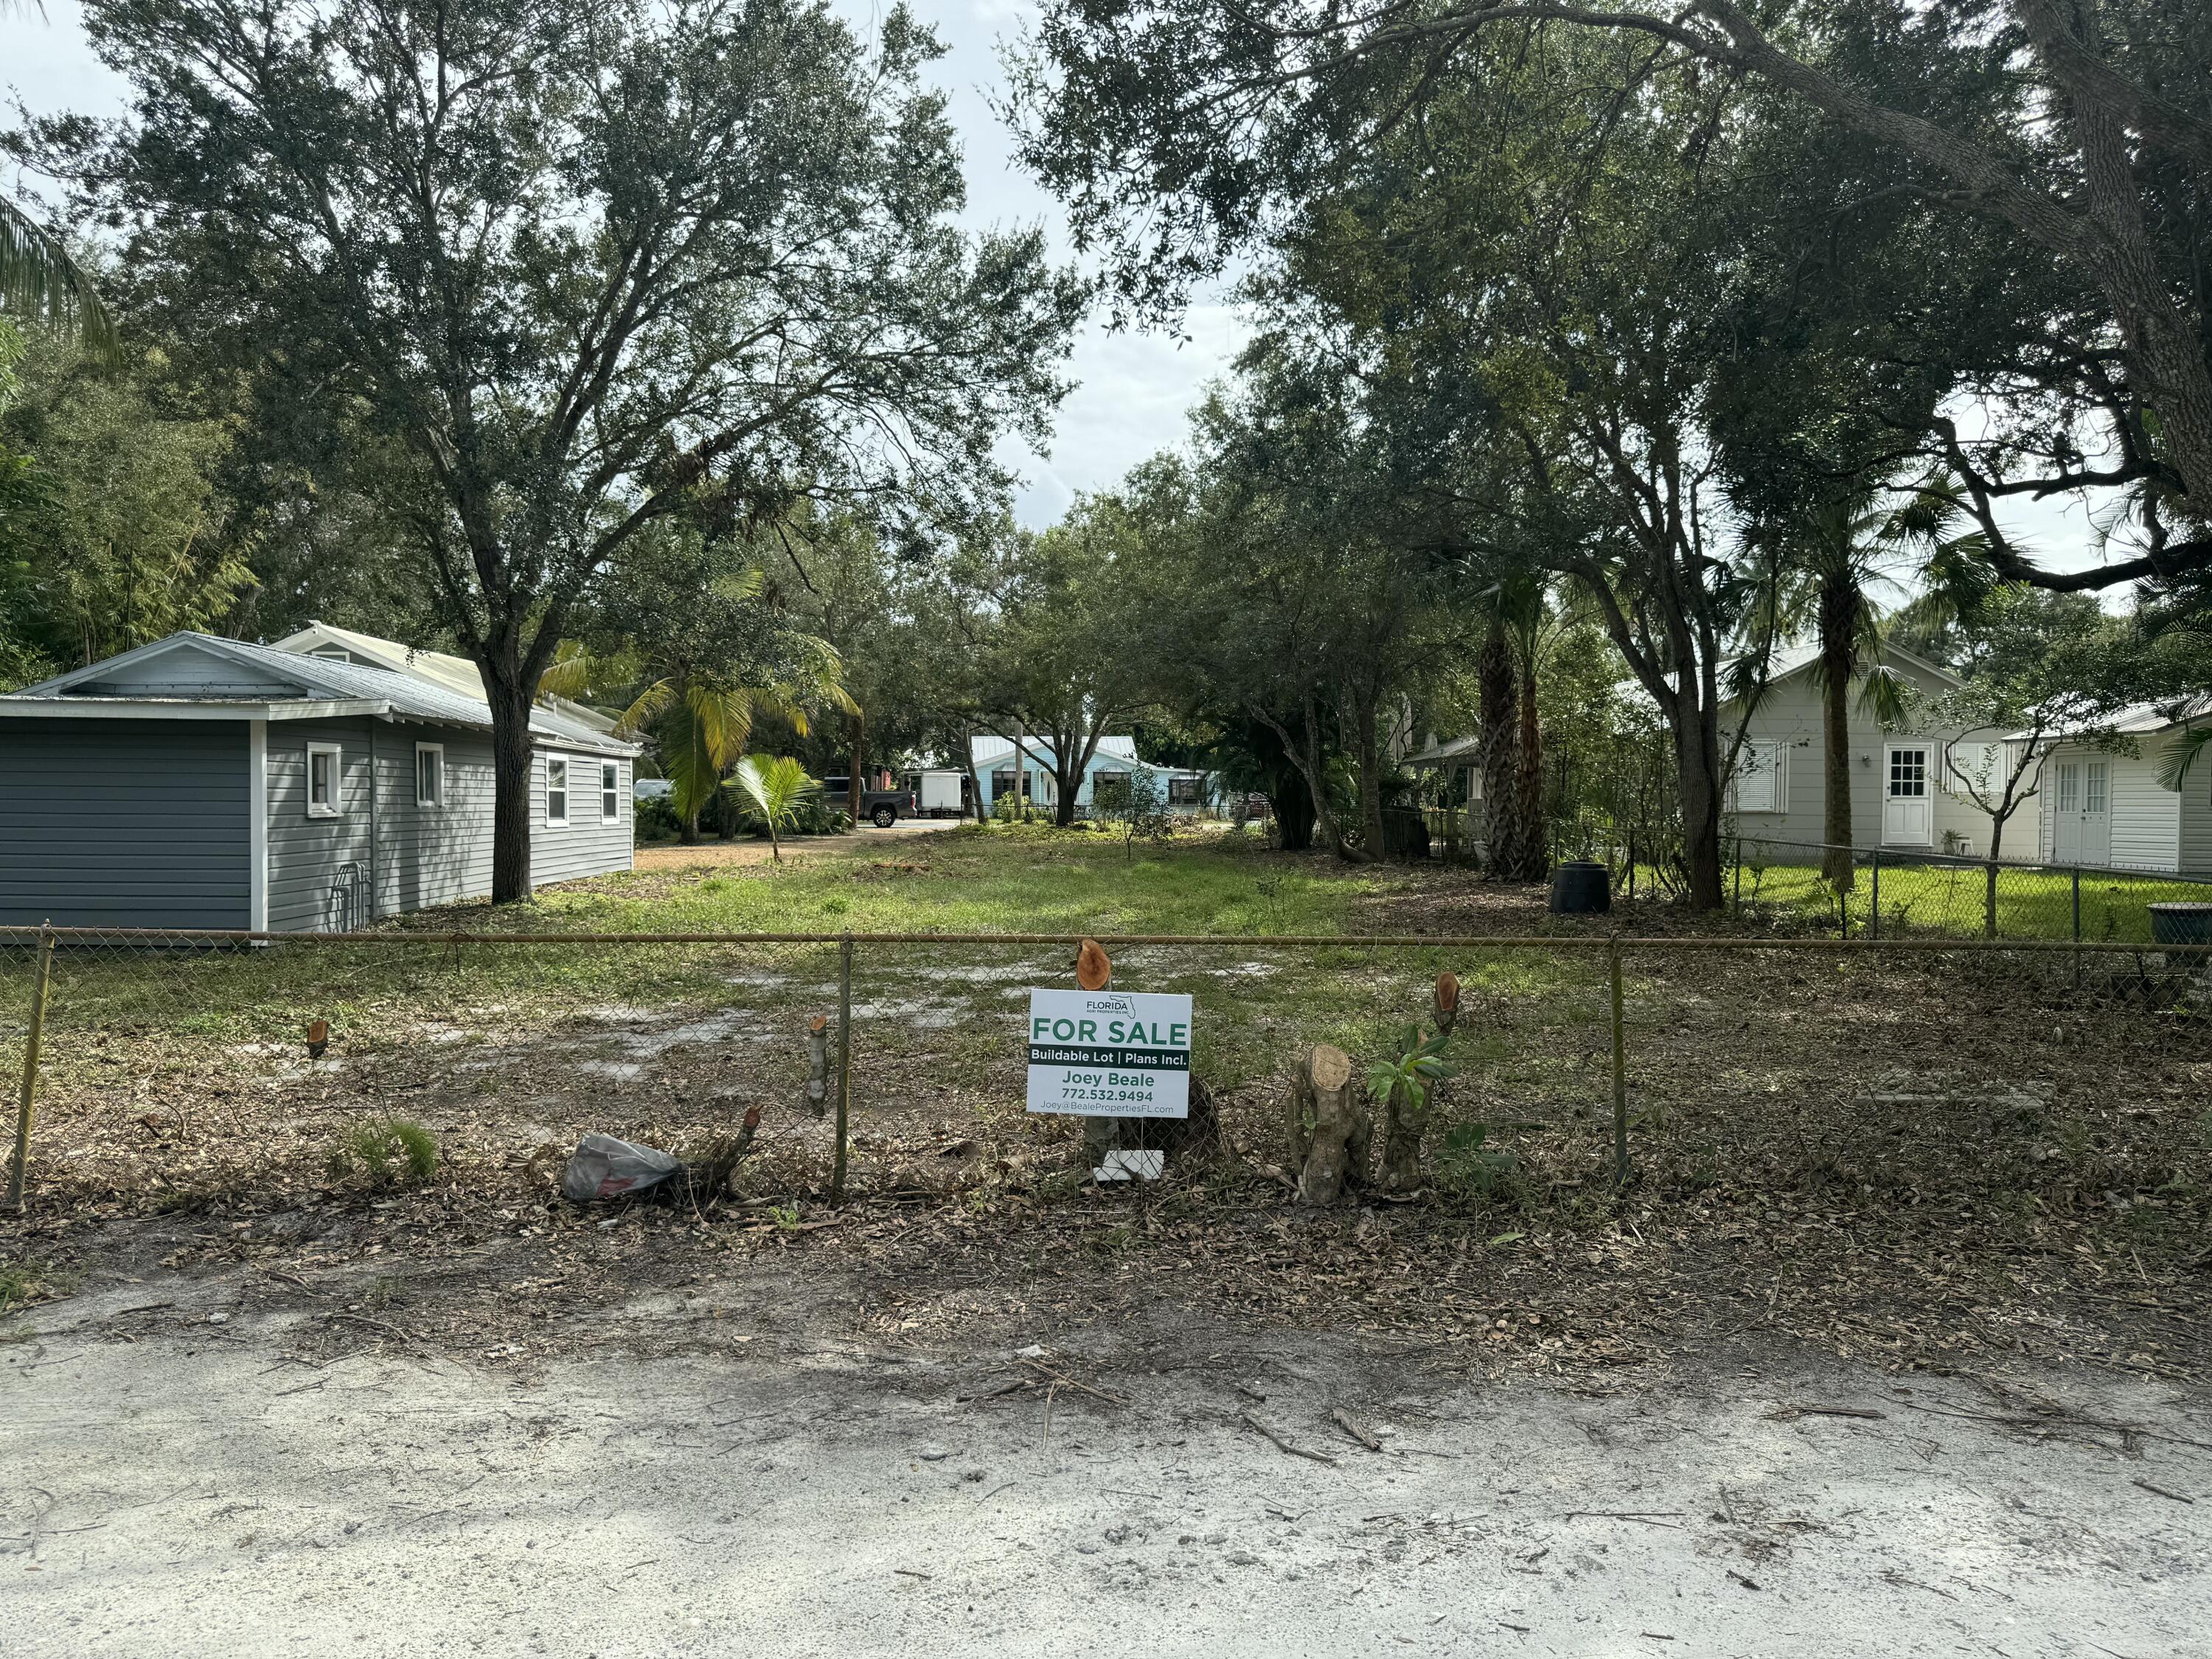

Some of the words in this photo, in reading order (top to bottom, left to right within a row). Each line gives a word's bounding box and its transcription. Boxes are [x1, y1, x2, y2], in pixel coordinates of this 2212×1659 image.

[1087, 1001, 1127, 1010] FLORIDA
[1034, 1018, 1097, 1042] FOR
[1108, 1021, 1186, 1046] SALE
[1032, 1049, 1089, 1062] Buildable
[1093, 1052, 1113, 1062] Lot
[1125, 1053, 1157, 1064] Plans
[1161, 1054, 1186, 1065] Incl.
[1062, 1071, 1102, 1087] Joey
[1108, 1073, 1154, 1087] Beale
[1062, 1088, 1152, 1102] 772.532.9494
[1040, 1101, 1173, 1113] Joey@BealePropertiesFL.com
